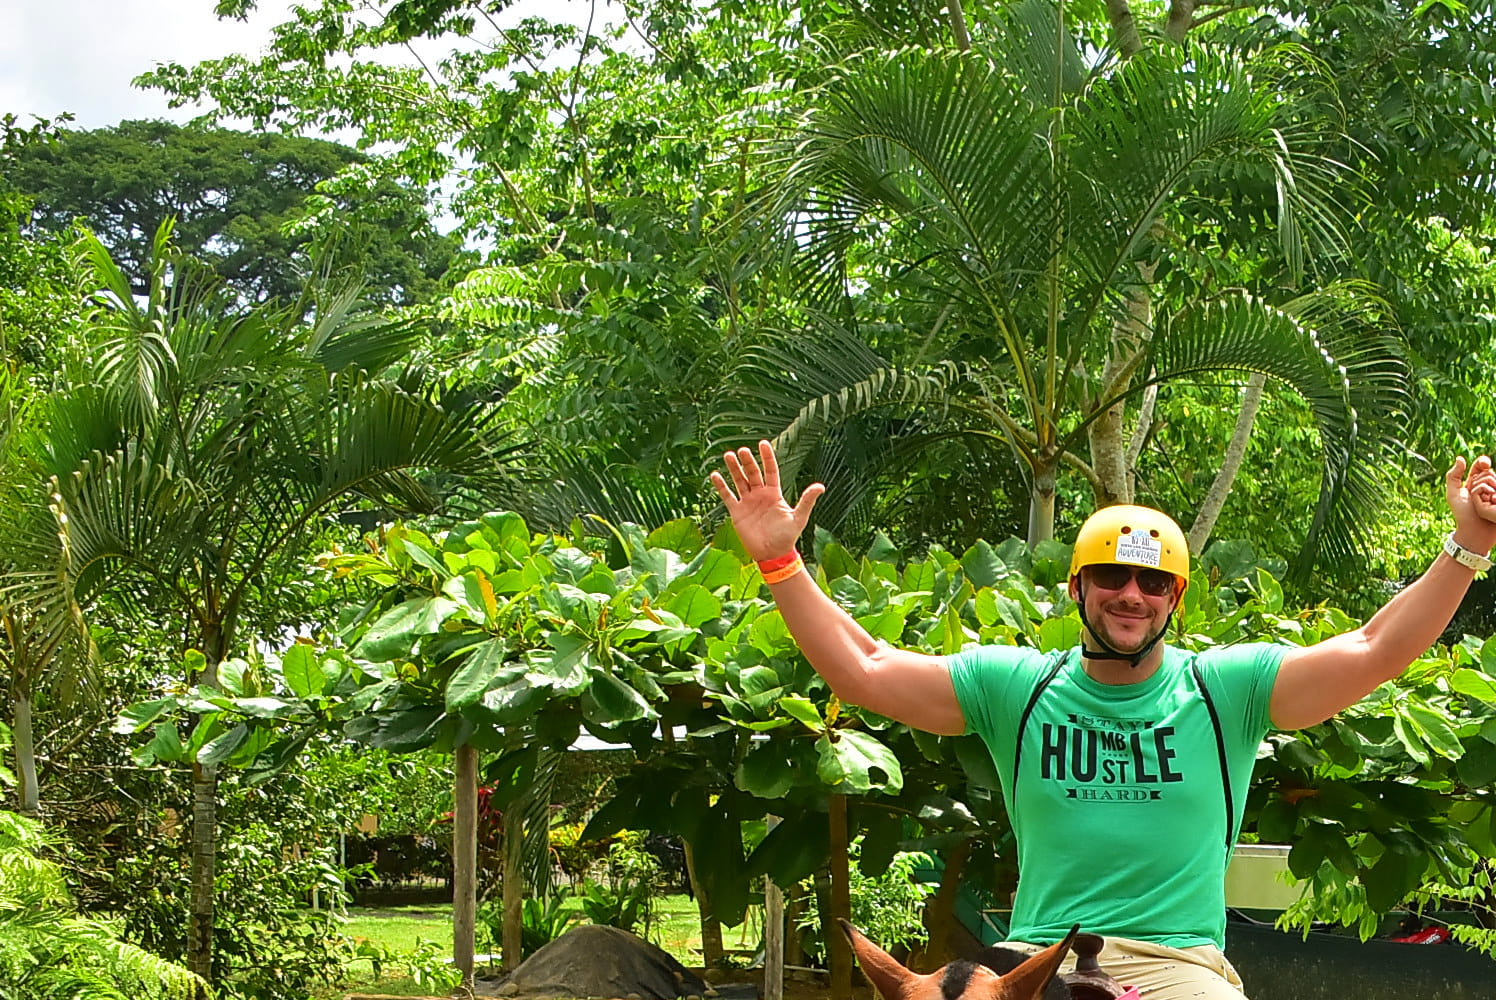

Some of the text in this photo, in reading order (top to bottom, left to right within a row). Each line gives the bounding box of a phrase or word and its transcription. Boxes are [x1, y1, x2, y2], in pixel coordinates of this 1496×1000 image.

[1118, 548, 1158, 562] ADVENTURE
[1081, 715, 1142, 731] STAY
[1081, 789, 1148, 801] HARD
